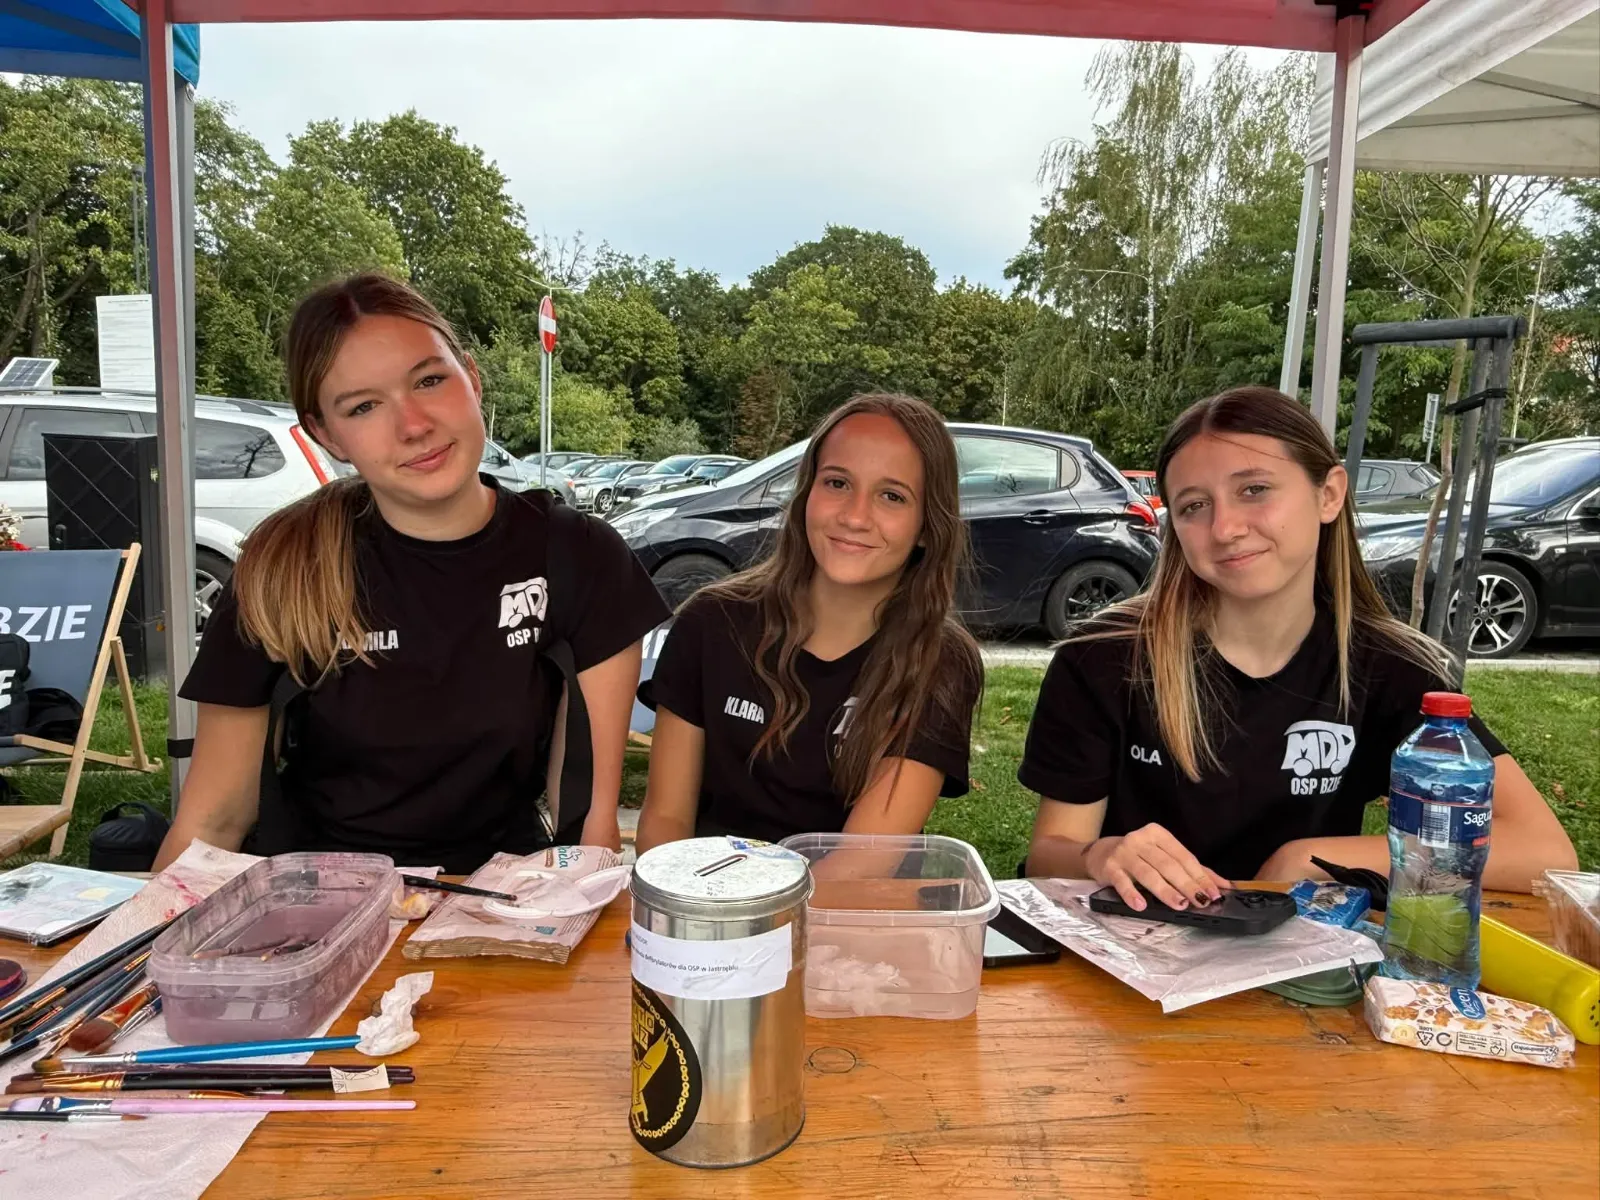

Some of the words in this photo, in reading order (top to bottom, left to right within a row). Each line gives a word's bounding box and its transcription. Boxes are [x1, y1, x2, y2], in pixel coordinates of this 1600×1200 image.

[506, 628, 531, 648] OSP
[724, 696, 765, 724] KLARA
[1131, 745, 1162, 766] OLA
[1290, 777, 1318, 795] OSP
